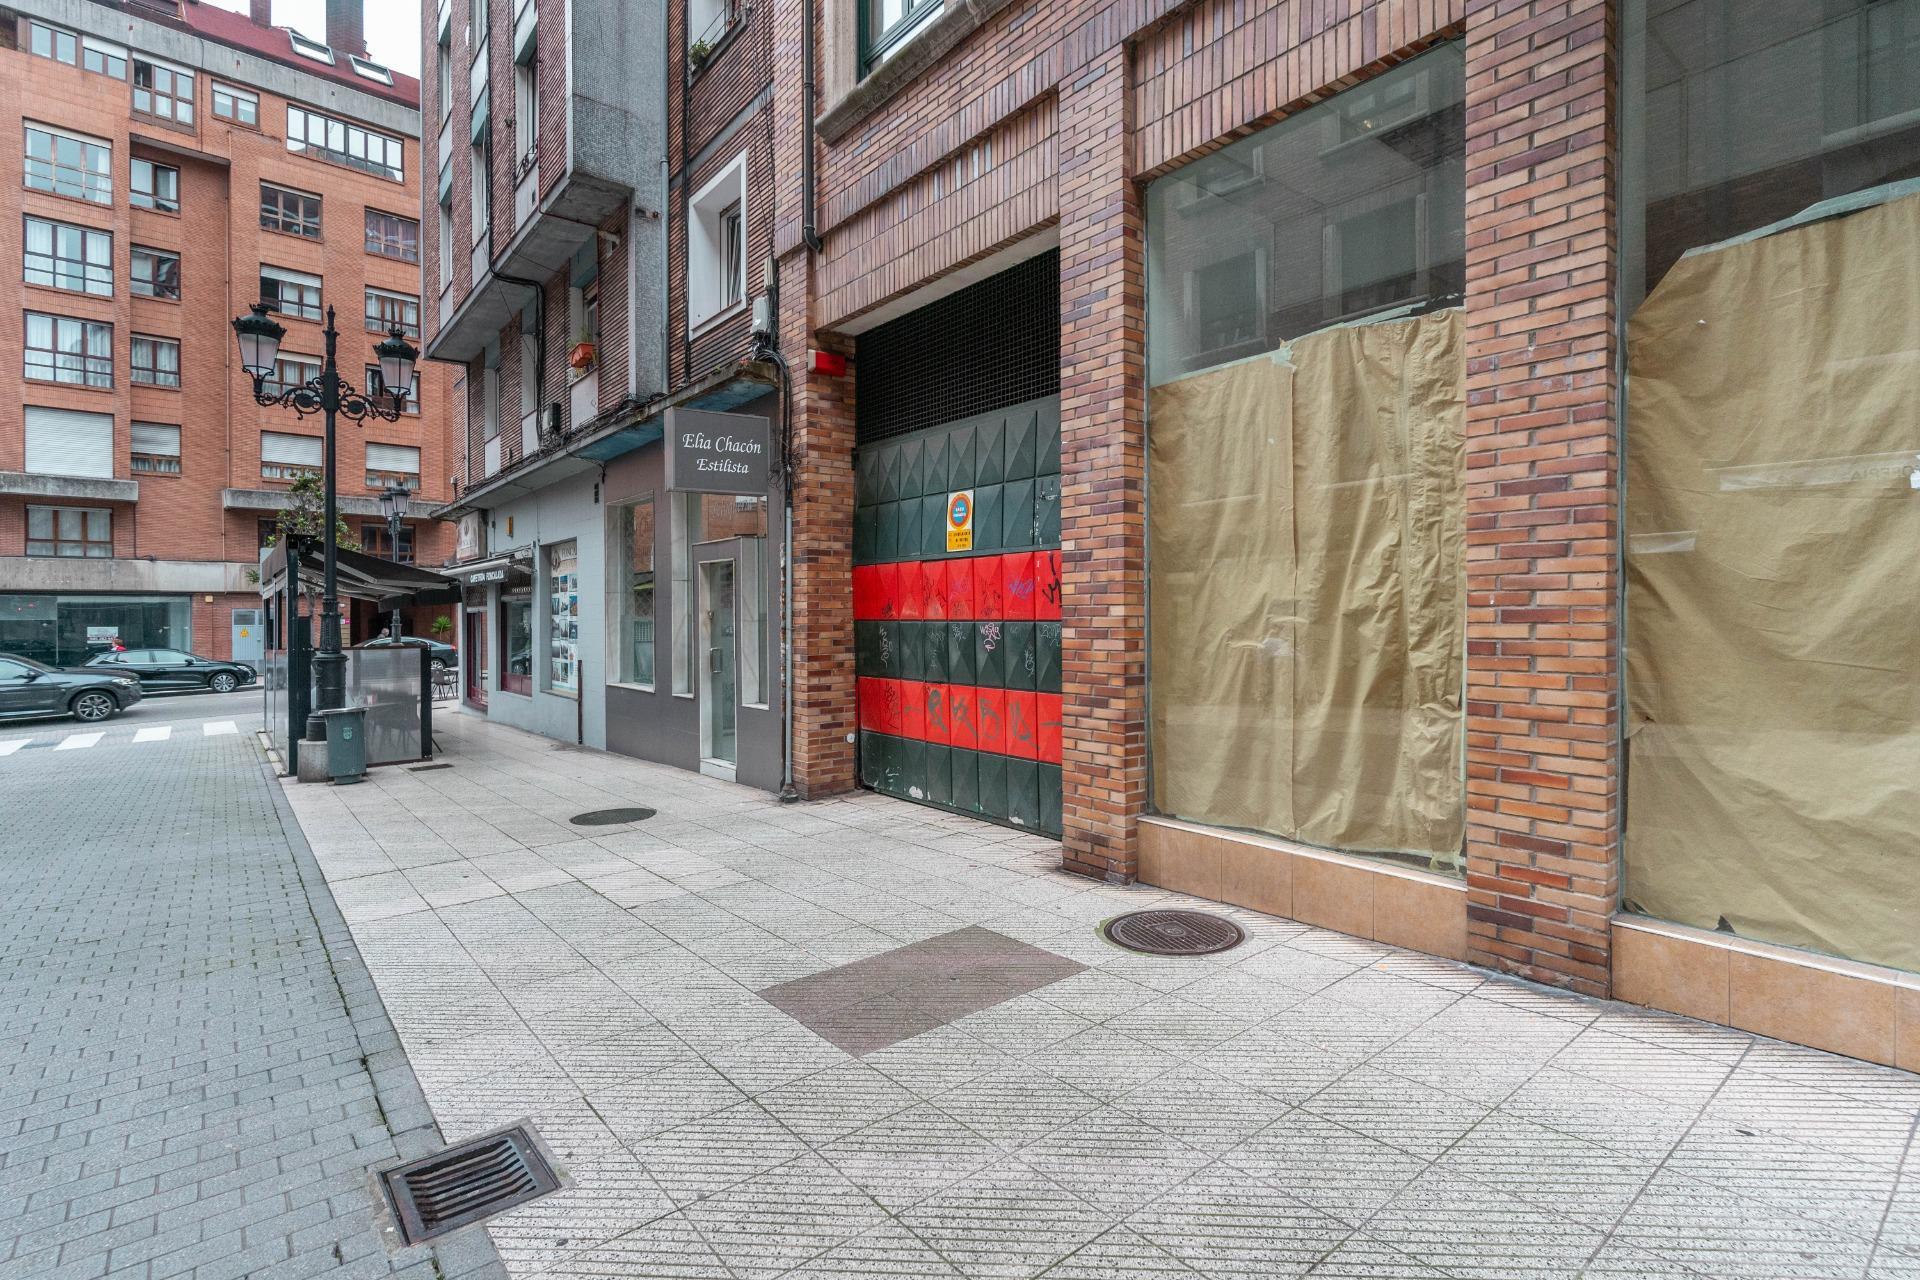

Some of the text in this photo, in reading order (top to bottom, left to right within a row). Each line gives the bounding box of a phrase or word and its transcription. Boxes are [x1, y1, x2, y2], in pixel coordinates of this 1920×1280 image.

[682, 432, 762, 454] Elia Chacón
[696, 458, 749, 474] Estilista
